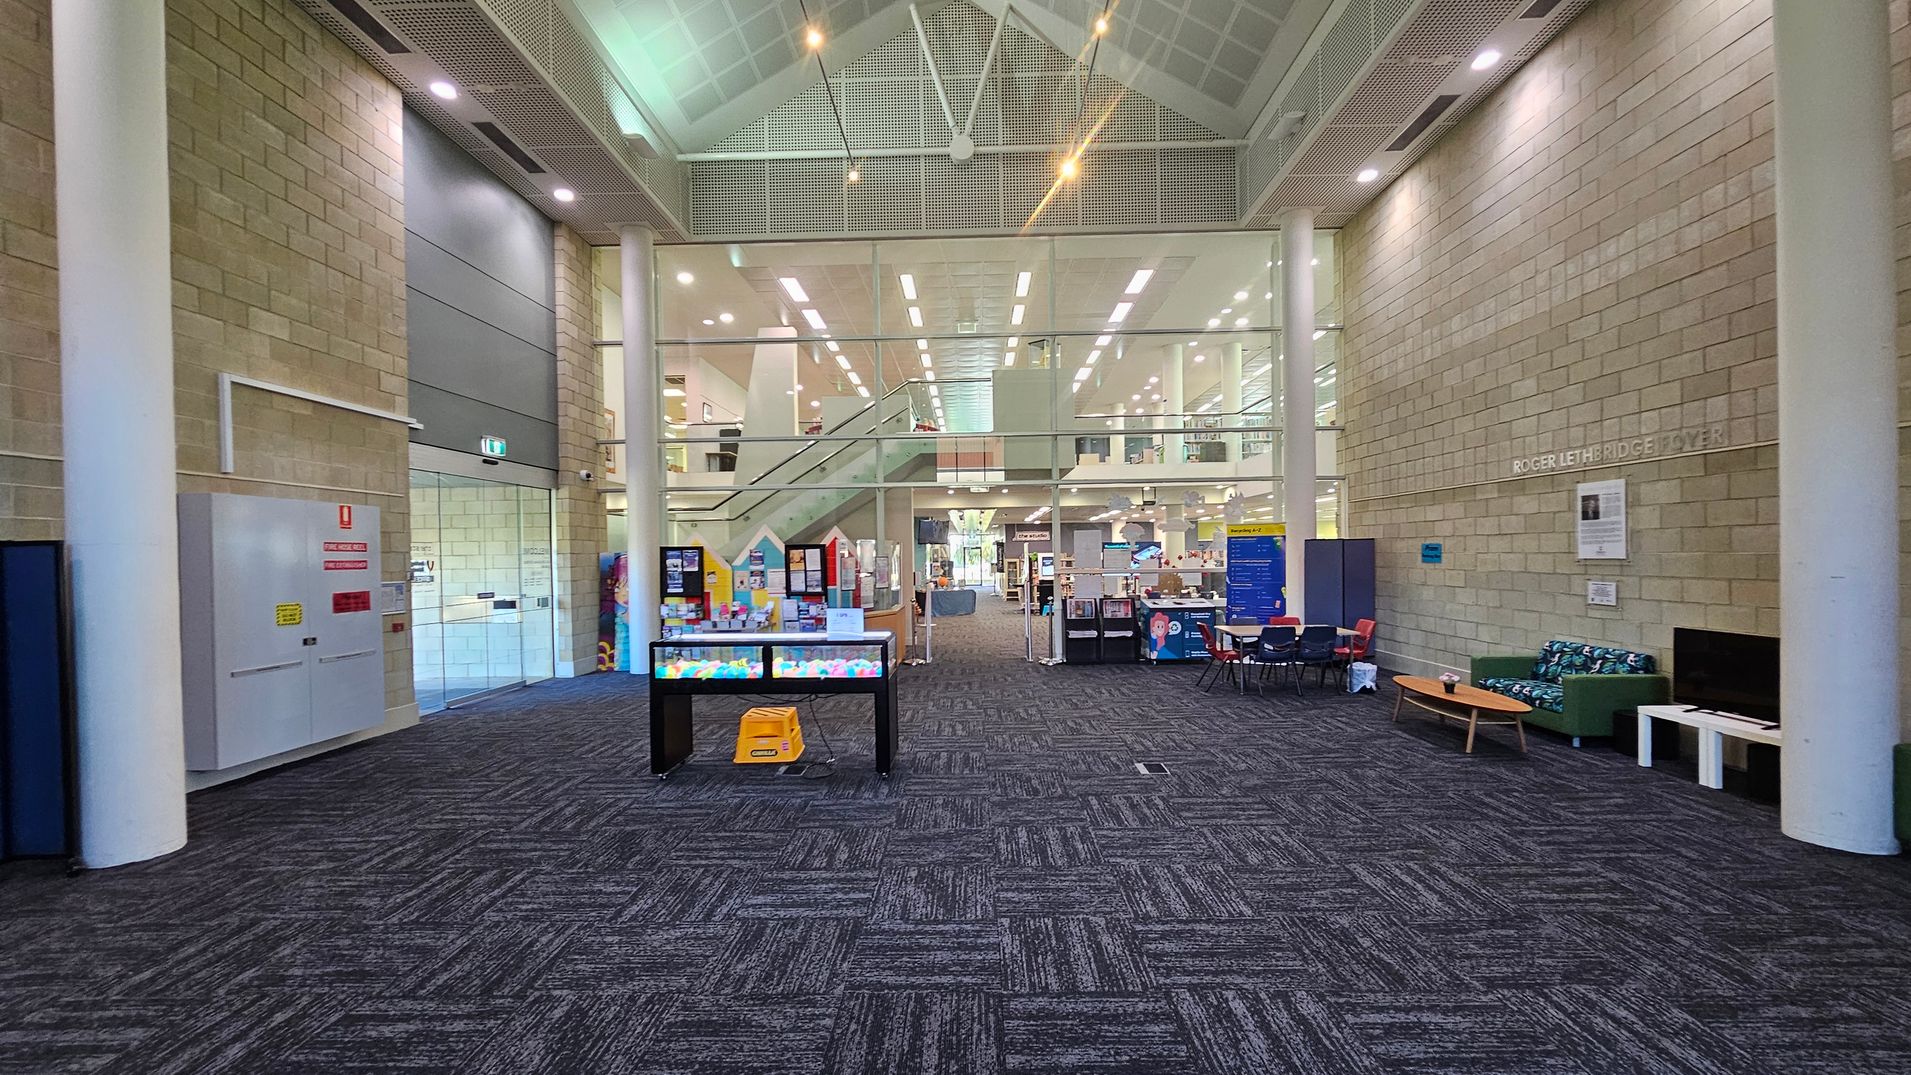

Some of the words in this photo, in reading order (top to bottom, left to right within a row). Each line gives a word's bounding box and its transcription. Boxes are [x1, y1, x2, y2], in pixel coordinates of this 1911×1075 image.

[1513, 454, 1557, 474] ROGER
[1559, 438, 1655, 468] LETHBRIDGE
[1660, 426, 1726, 452] FOYER
[324, 543, 337, 551] FIRE
[338, 543, 352, 551] HOSE
